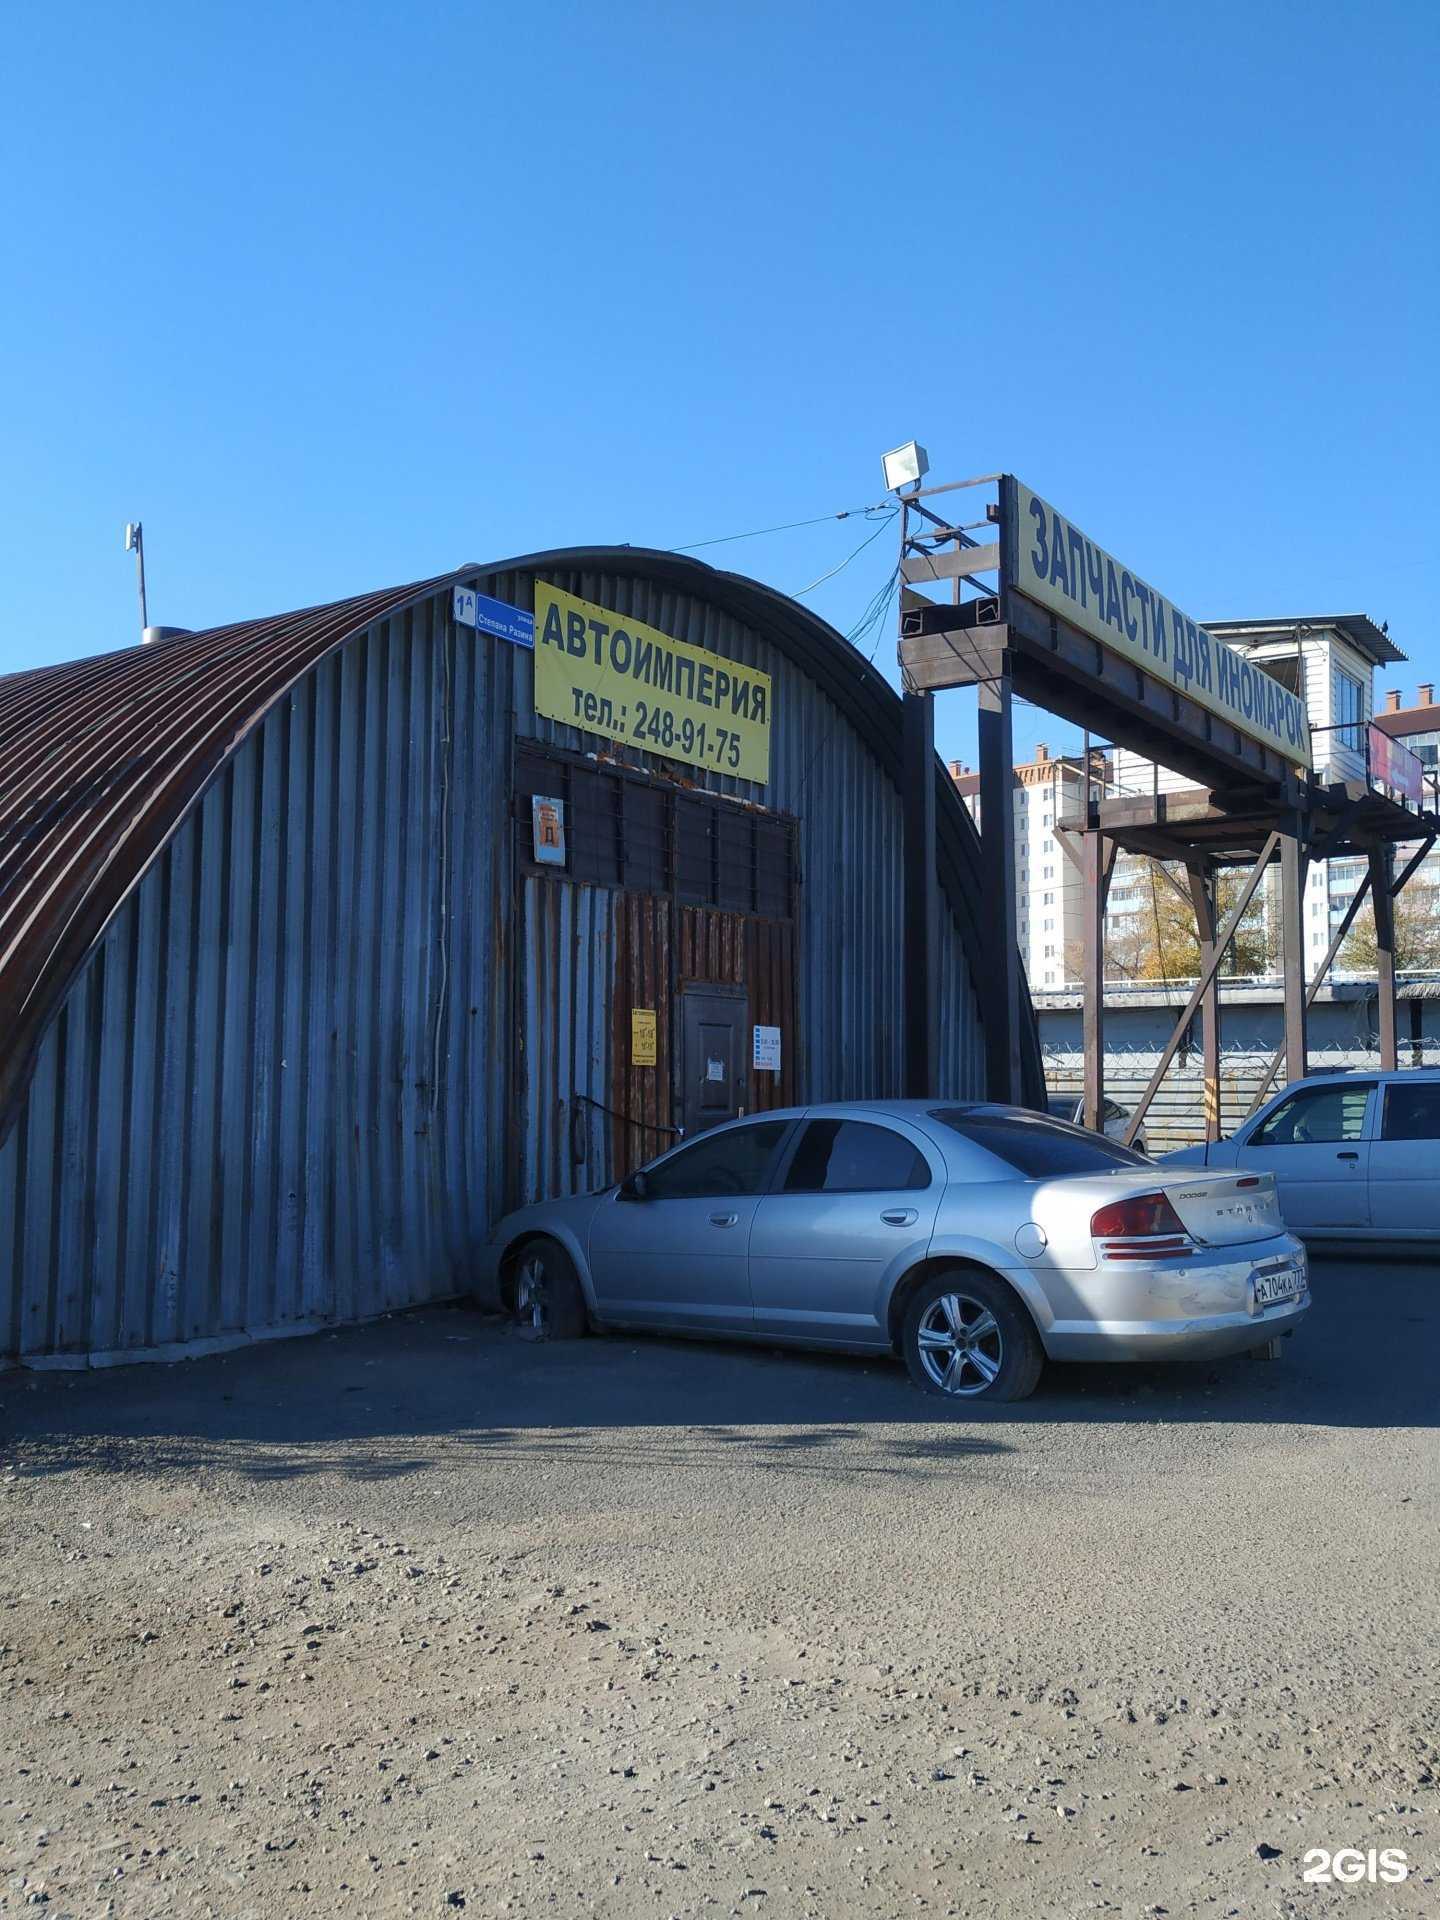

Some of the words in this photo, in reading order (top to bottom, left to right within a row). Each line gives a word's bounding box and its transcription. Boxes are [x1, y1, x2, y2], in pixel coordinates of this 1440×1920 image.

[479, 614, 507, 633] Степана
[509, 624, 533, 642] Разина
[542, 602, 766, 725] АВТОИМПЕРИЯ
[1029, 496, 1167, 664] ЗАПЧАСТИ
[1171, 608, 1213, 694] ДЛЯ
[1215, 642, 1306, 752] ИНОМАРОК
[572, 687, 627, 733] тел.:
[632, 701, 741, 768] 248-91-75
